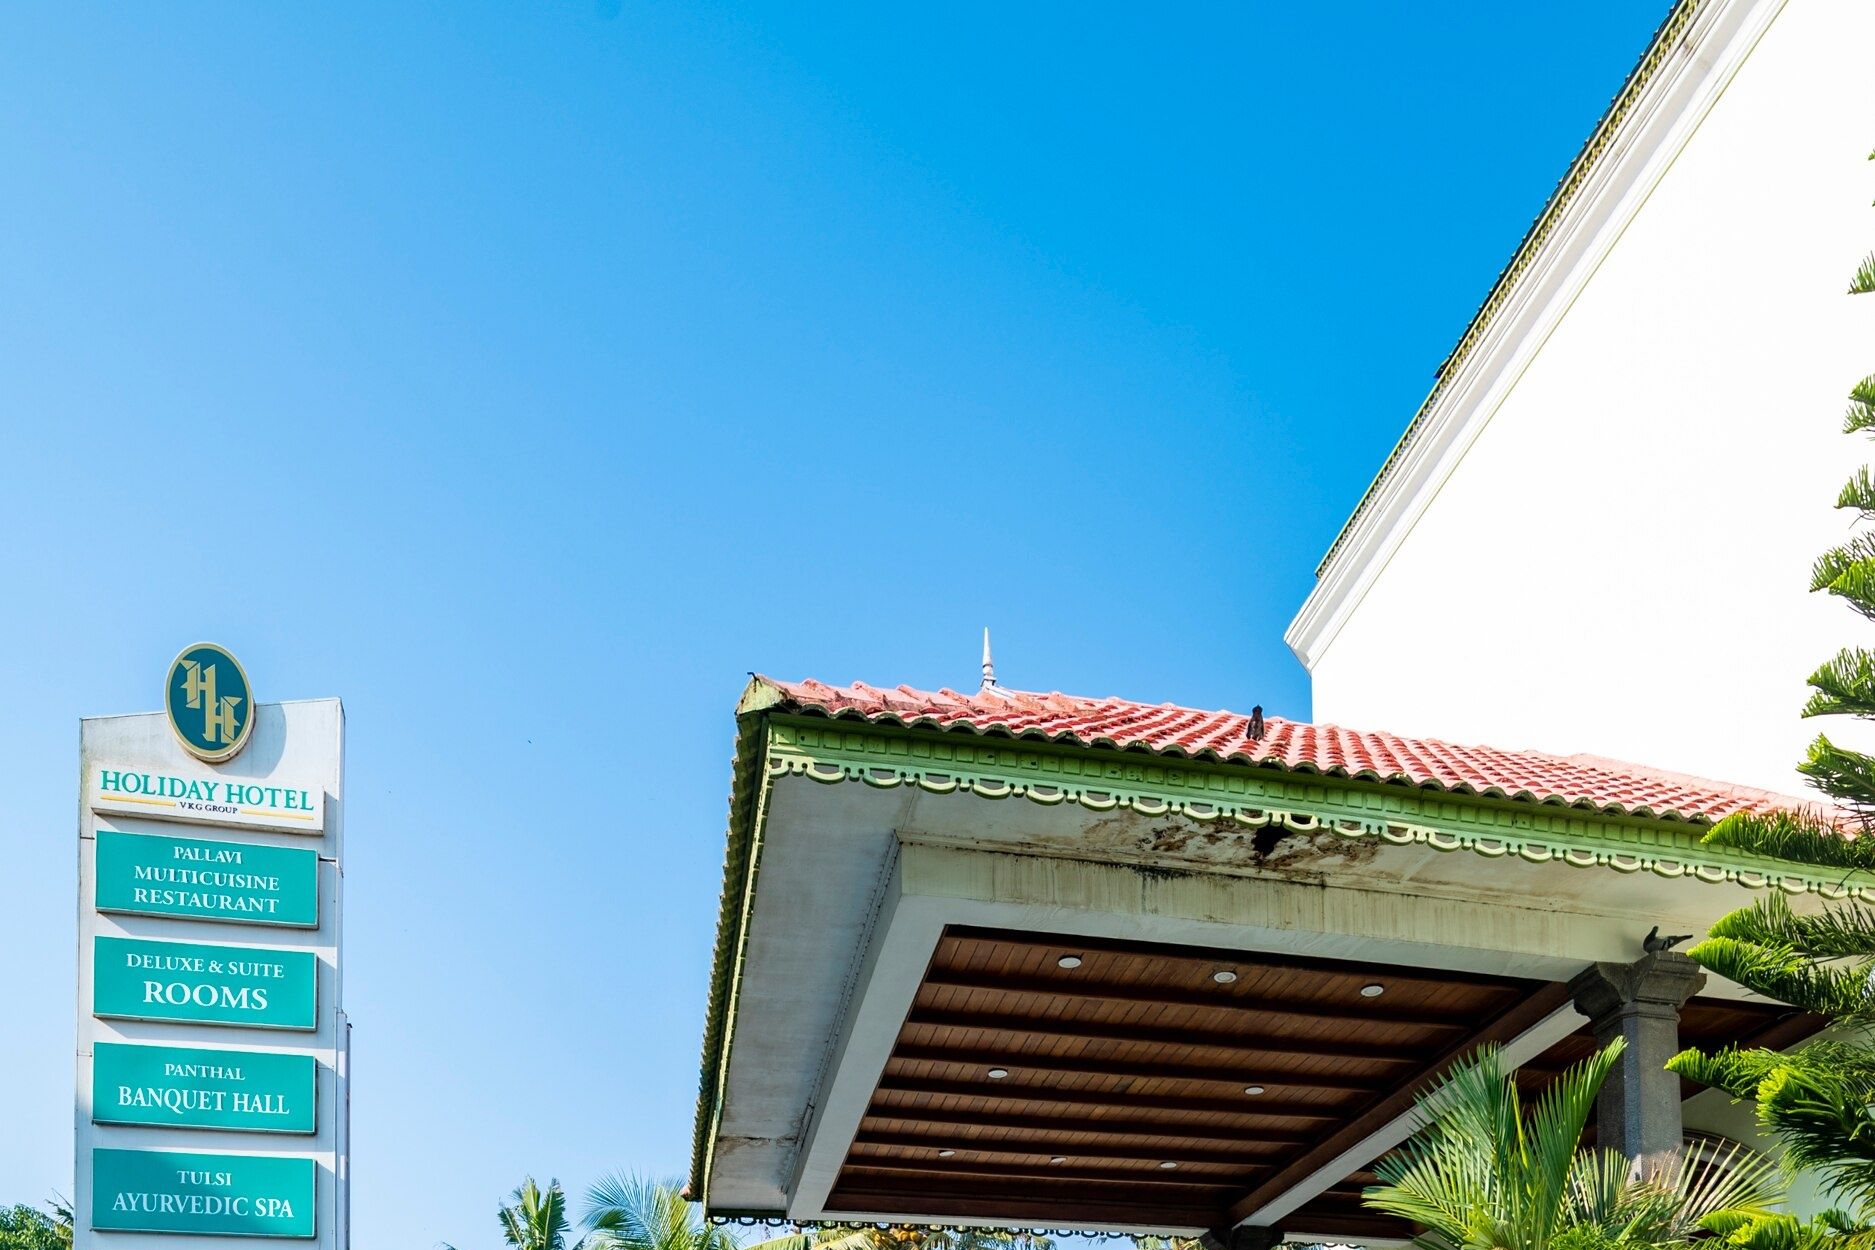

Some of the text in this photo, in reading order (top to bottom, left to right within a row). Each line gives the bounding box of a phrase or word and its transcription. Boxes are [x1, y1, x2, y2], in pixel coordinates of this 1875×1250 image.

[100, 770, 314, 811] HOLIDAY HOTEL
[205, 804, 238, 814] GROUP
[173, 846, 242, 864] PALLAVI
[134, 865, 280, 891] MULTICUISINE
[134, 888, 280, 913] RESTAURANT
[127, 954, 284, 978] DELUXE & SUITE
[143, 981, 268, 1010] ROOMS
[165, 1063, 245, 1081] PANTHAL
[118, 1086, 290, 1114] BANQUET HALL
[177, 1170, 232, 1186] TULSI
[112, 1192, 294, 1218] AYURVEDIC SPA
